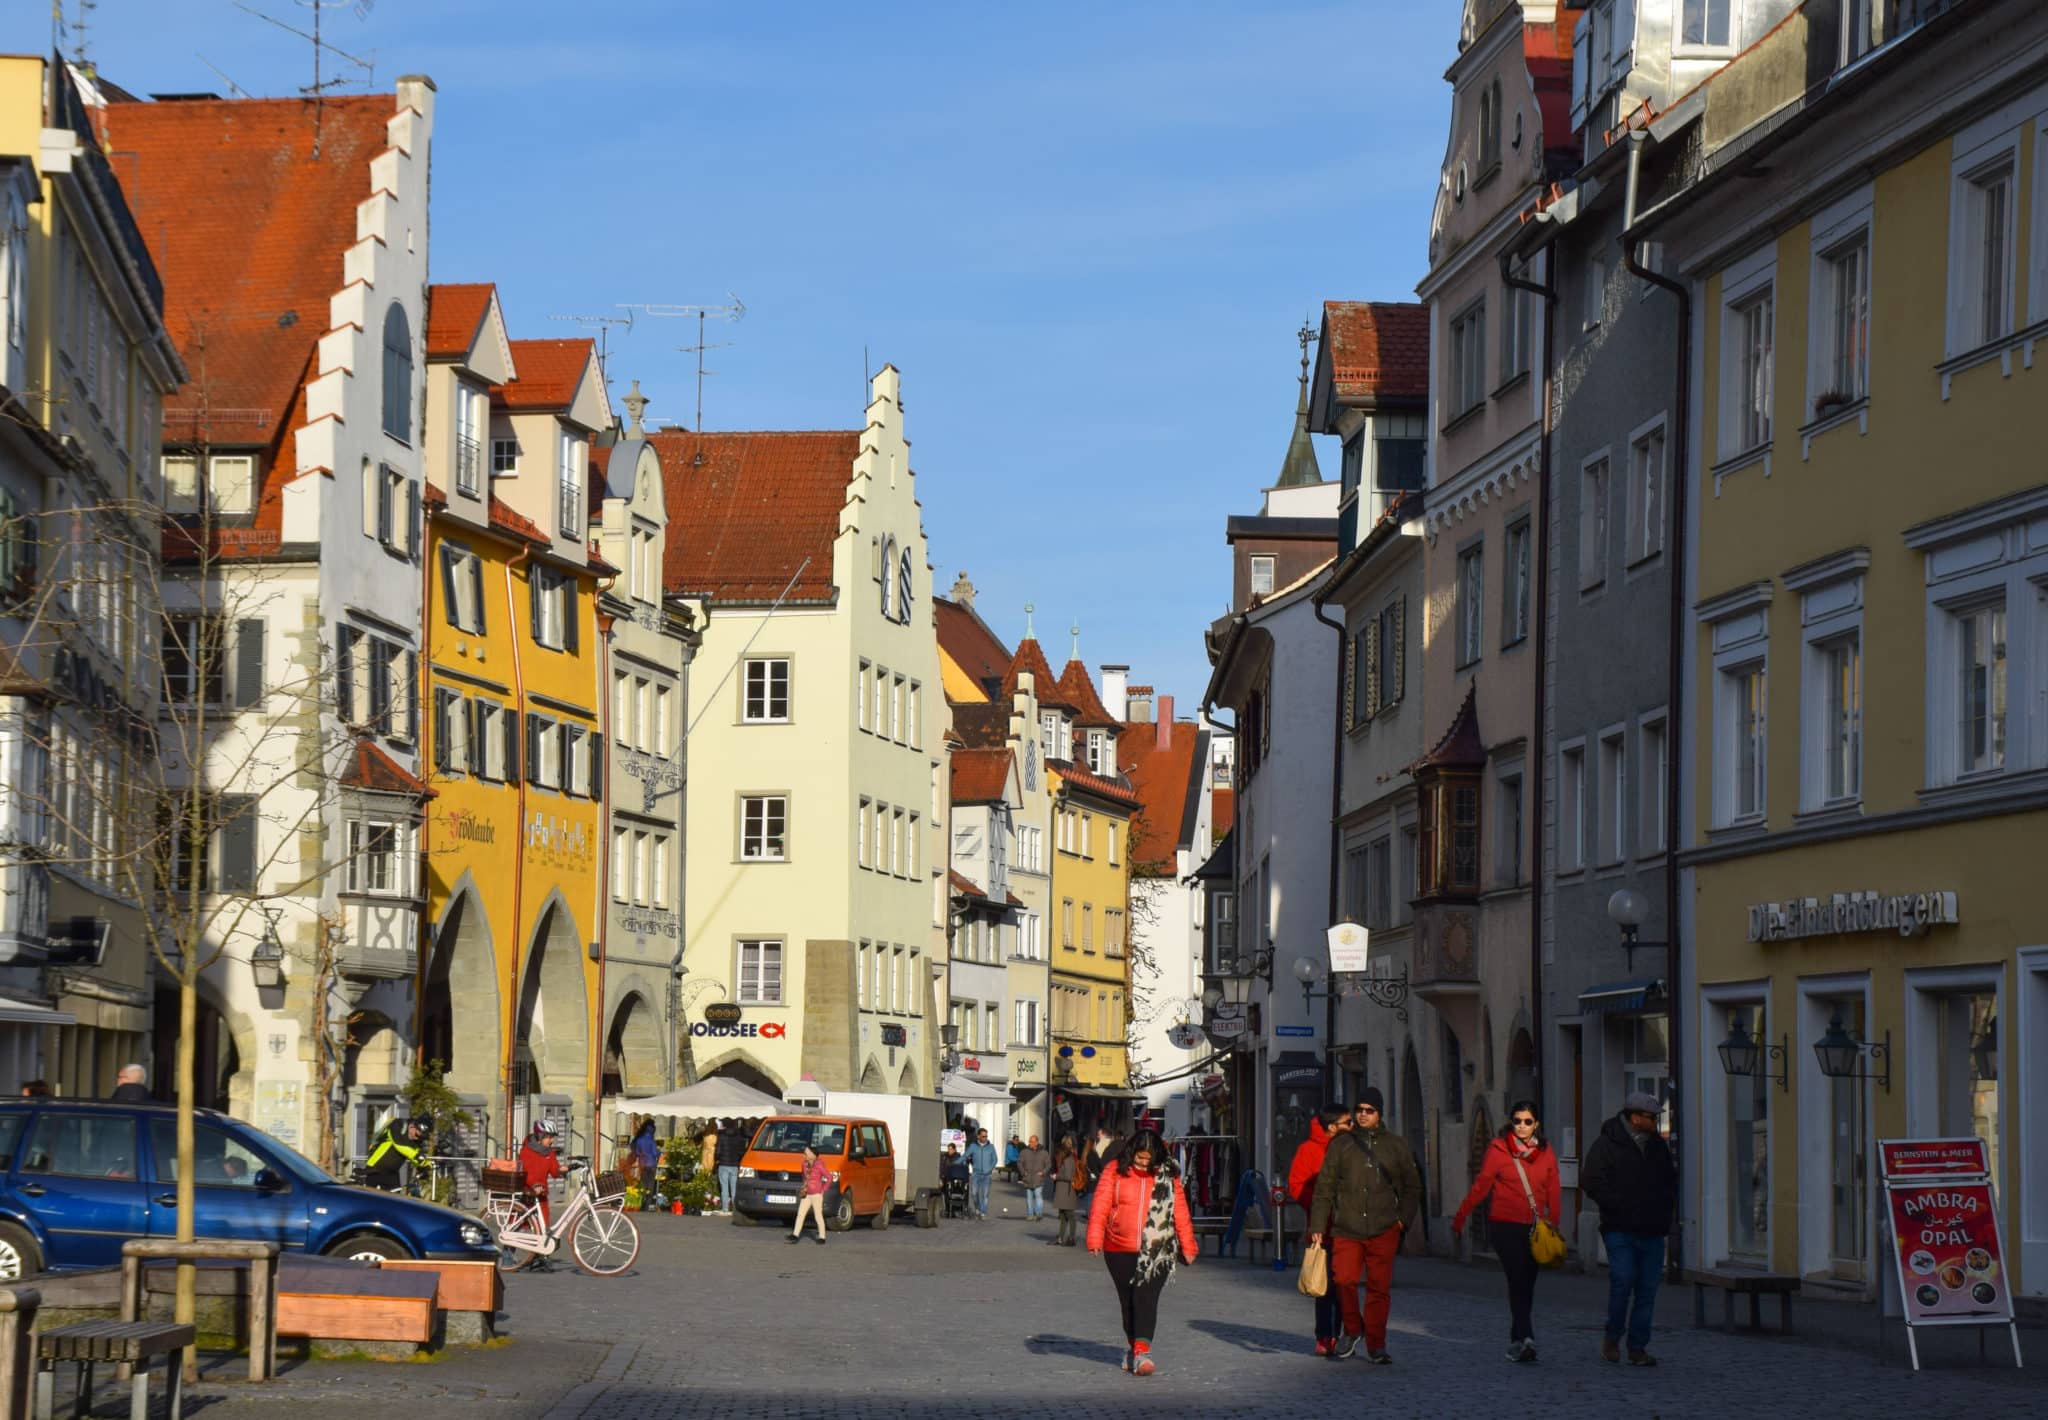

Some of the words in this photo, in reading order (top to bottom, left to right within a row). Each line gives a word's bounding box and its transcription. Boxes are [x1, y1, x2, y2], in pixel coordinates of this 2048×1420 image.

[1893, 1150, 1939, 1159] BERNSTEIN
[1904, 1193, 1977, 1216] AMBRA
[1920, 1229, 1974, 1246] OPAL
